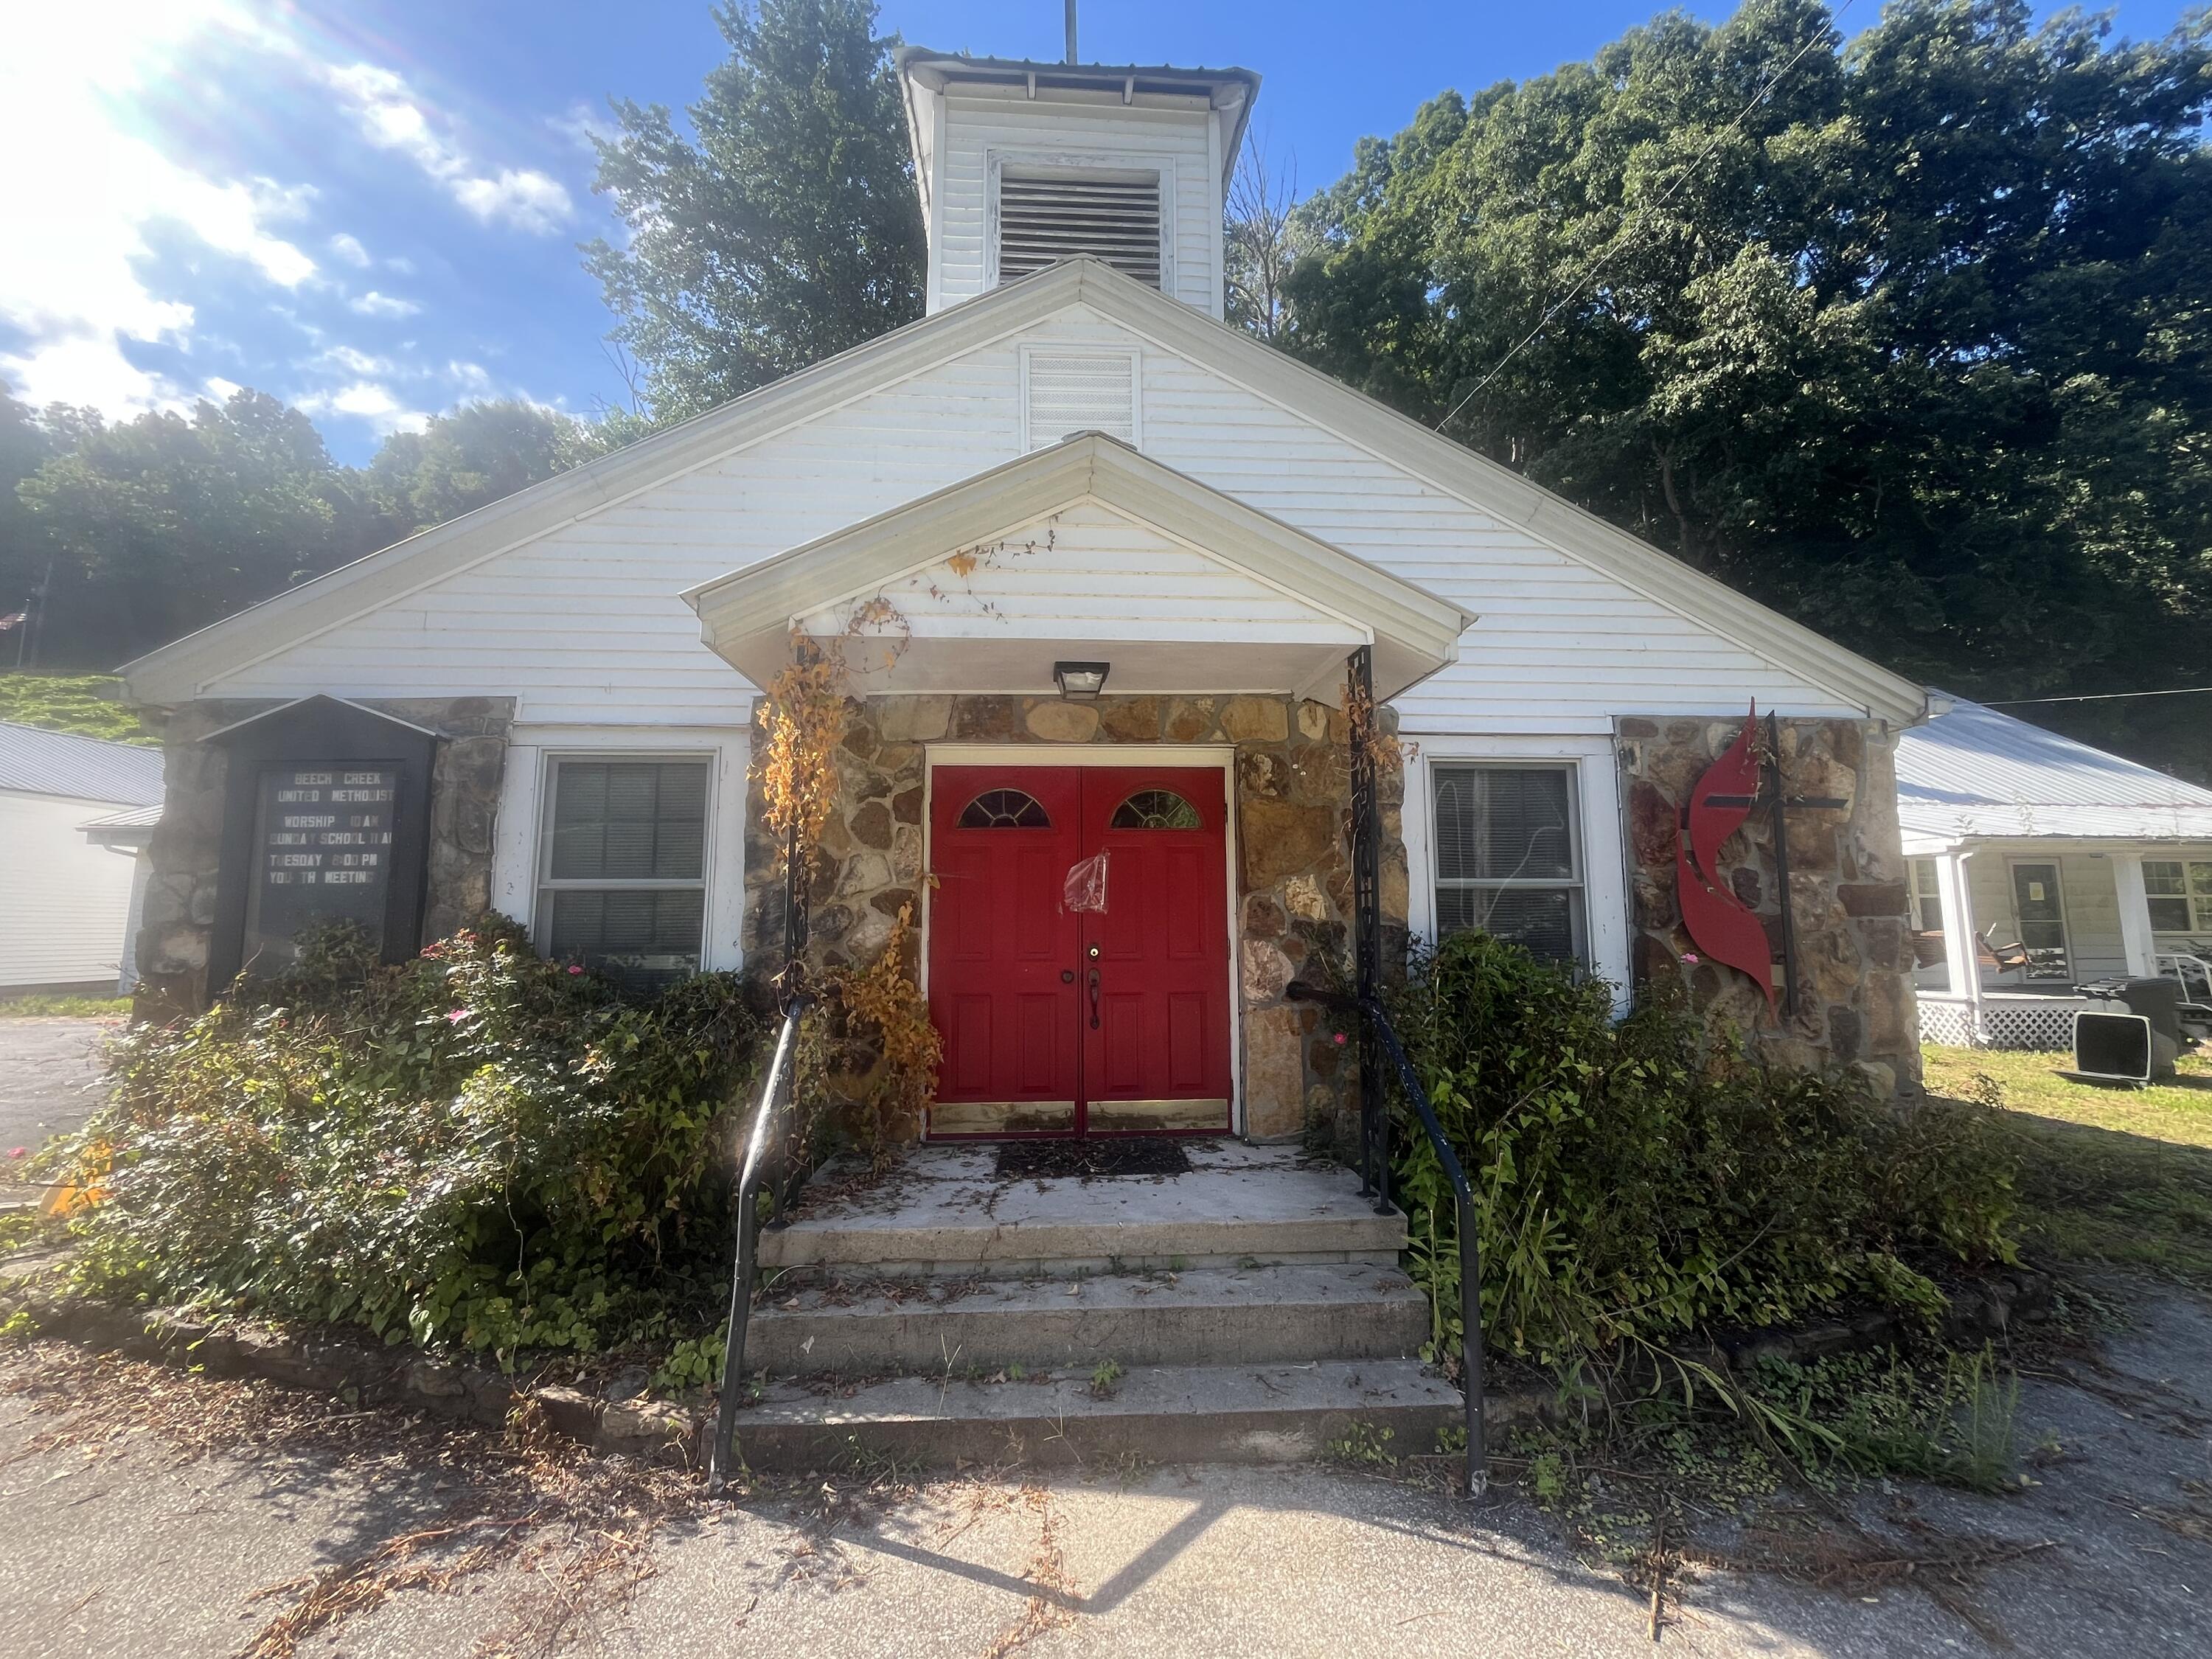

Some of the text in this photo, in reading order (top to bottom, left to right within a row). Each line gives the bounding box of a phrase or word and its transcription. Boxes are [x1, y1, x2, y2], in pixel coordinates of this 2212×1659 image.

[295, 773, 381, 785] BEECH CREEK
[278, 790, 395, 802] UNITED METHODIST
[285, 815, 335, 827] WORSHIP
[319, 832, 366, 844] SCHOOL
[270, 854, 322, 866] TUESDAY
[361, 854, 378, 866] PM
